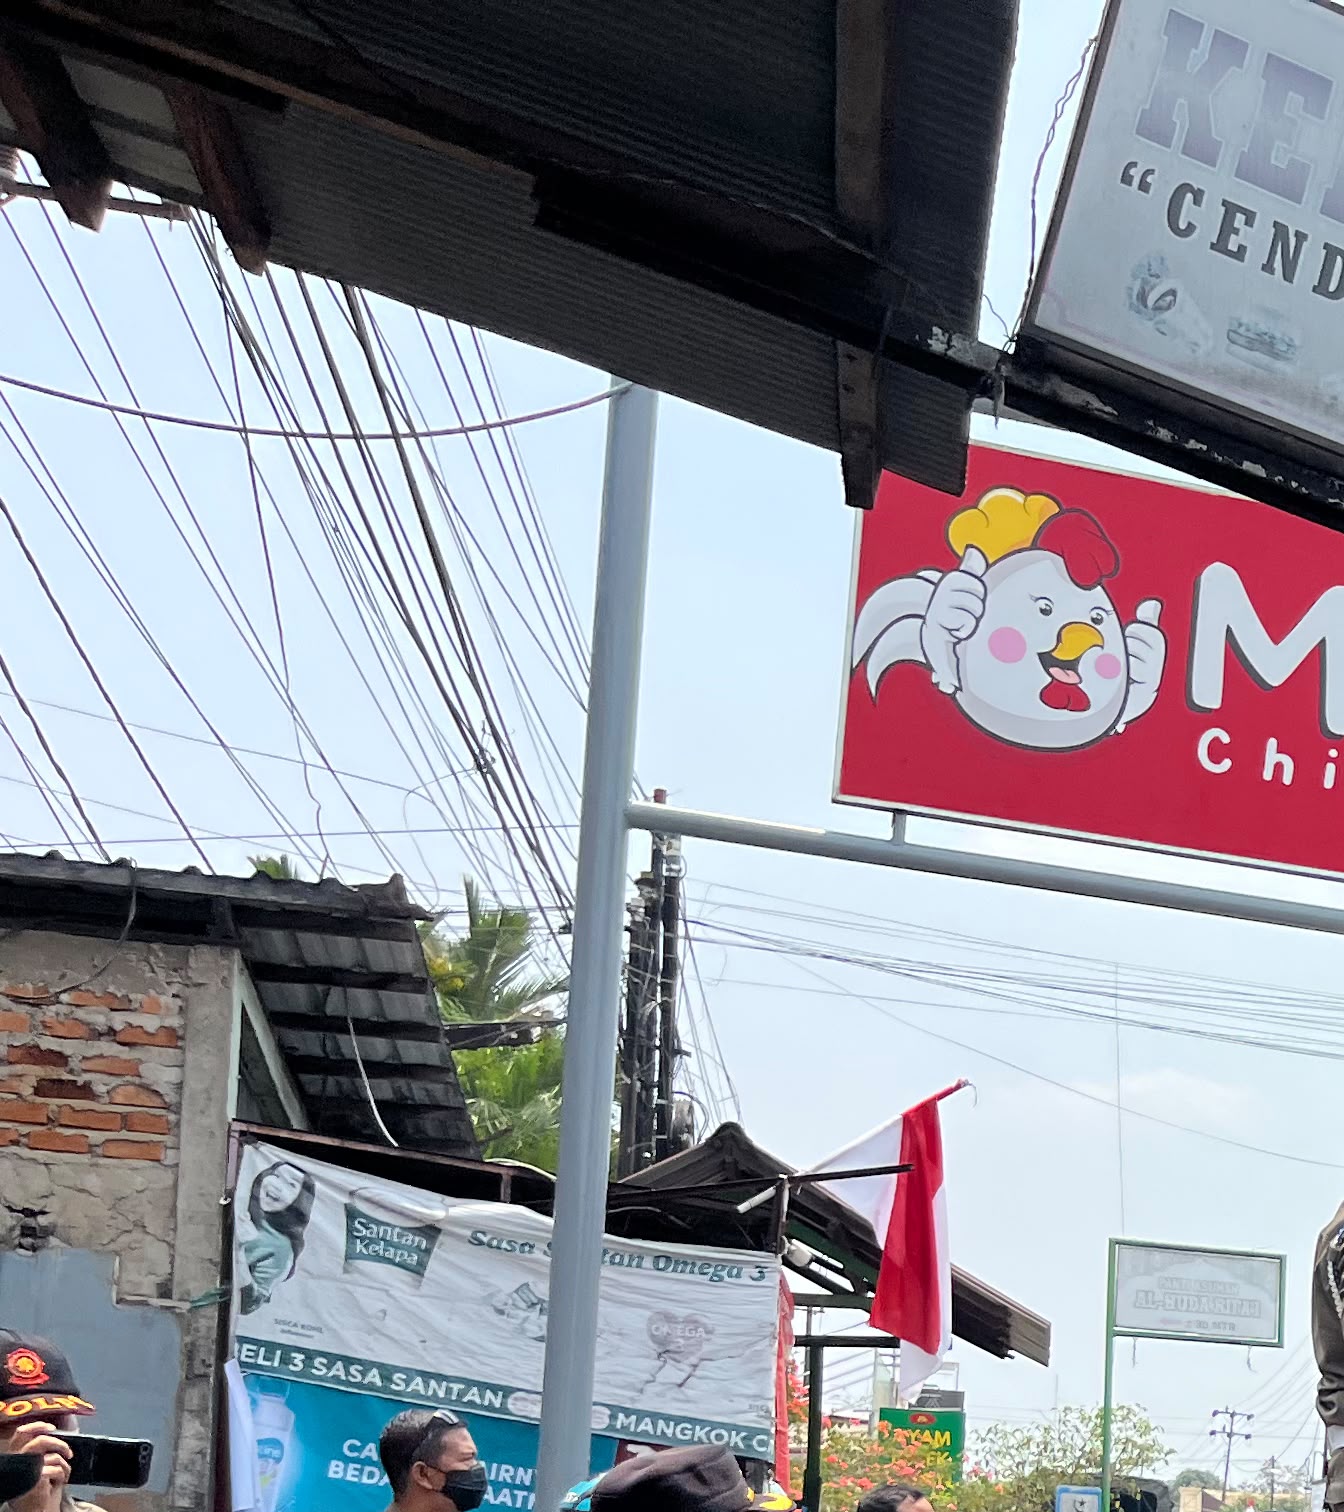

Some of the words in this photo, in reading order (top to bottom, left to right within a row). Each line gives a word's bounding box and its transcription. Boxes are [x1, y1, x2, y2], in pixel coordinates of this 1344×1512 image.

[352, 1217, 427, 1250] Santan
[355, 1239, 419, 1266] Kelapa
[468, 1230, 536, 1255] Sasa
[652, 1253, 743, 1282] Omega
[749, 1265, 767, 1282] 3
[288, 1352, 305, 1372] 3
[310, 1357, 384, 1388] SASA
[389, 1372, 503, 1409] SANTAN
[614, 1412, 748, 1450] MANGKOK
